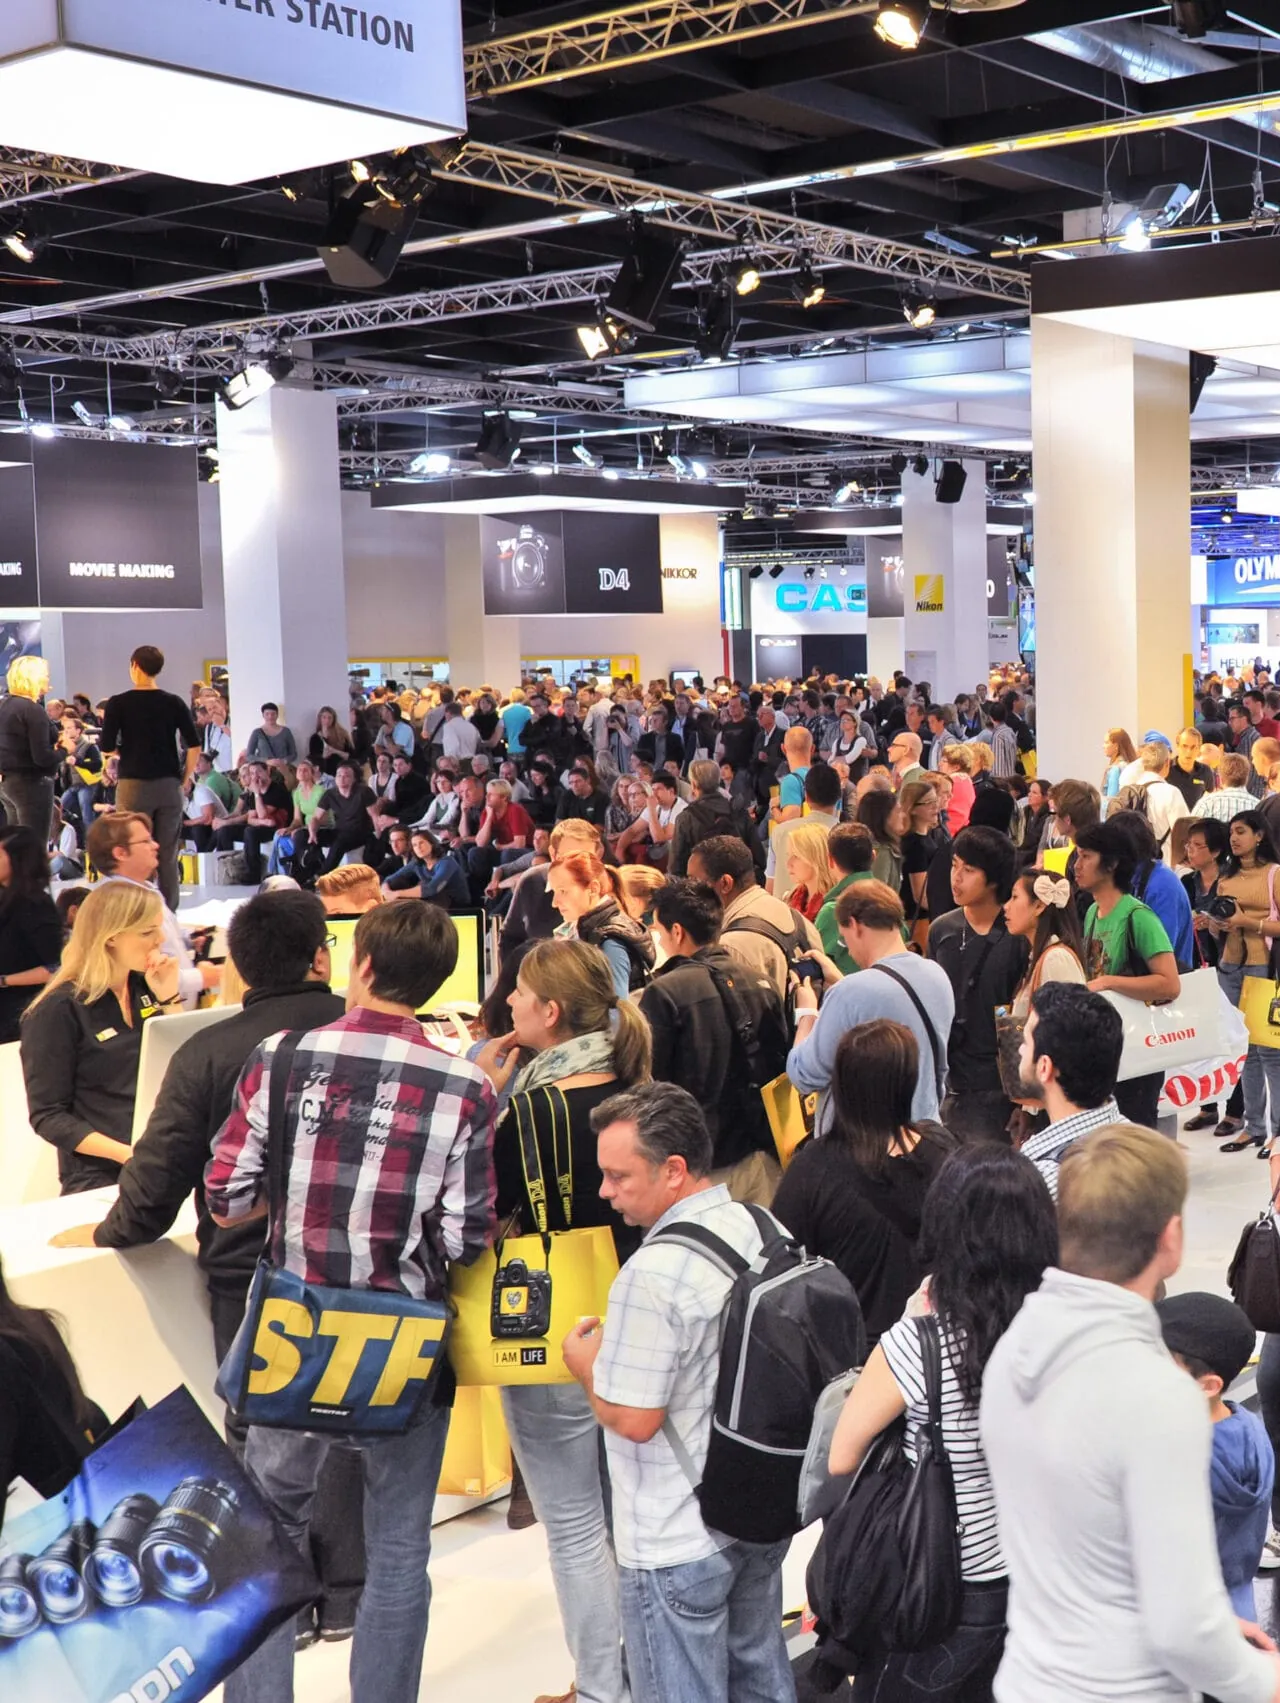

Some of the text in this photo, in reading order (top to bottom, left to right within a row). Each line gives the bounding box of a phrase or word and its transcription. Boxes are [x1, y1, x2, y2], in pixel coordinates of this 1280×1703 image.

[287, 0, 414, 53] STATION
[69, 562, 175, 579] MOVIE MAKING
[660, 567, 698, 579] NIKKOR
[598, 568, 630, 591] D4
[915, 601, 945, 613] Nikon
[1145, 1028, 1196, 1047] Canon
[501, 1351, 517, 1362] AM
[522, 1350, 544, 1362] LIFE
